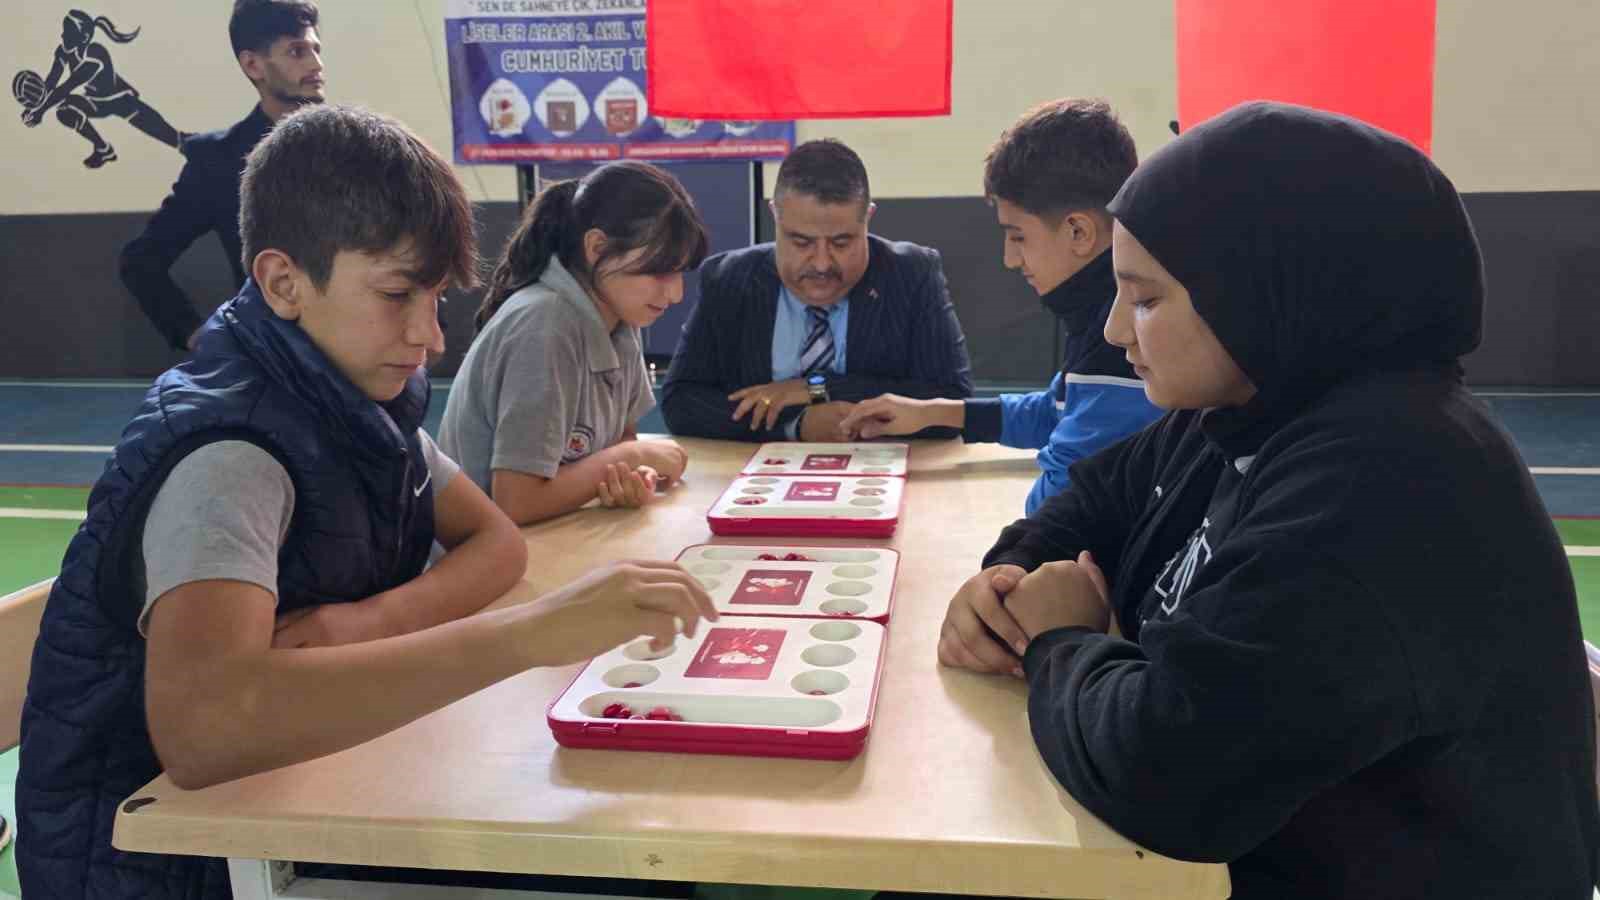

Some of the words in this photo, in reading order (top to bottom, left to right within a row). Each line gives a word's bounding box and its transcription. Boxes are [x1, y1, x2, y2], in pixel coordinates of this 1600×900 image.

[478, 1, 499, 13] SEN
[502, 1, 515, 13] DE
[519, 1, 569, 13] SAHNEYE
[461, 20, 527, 43] LİSELER
[528, 22, 575, 42] ARASI
[595, 21, 632, 41] AKIL
[632, 20, 646, 40] V
[501, 45, 625, 73] CUMHURİYET
